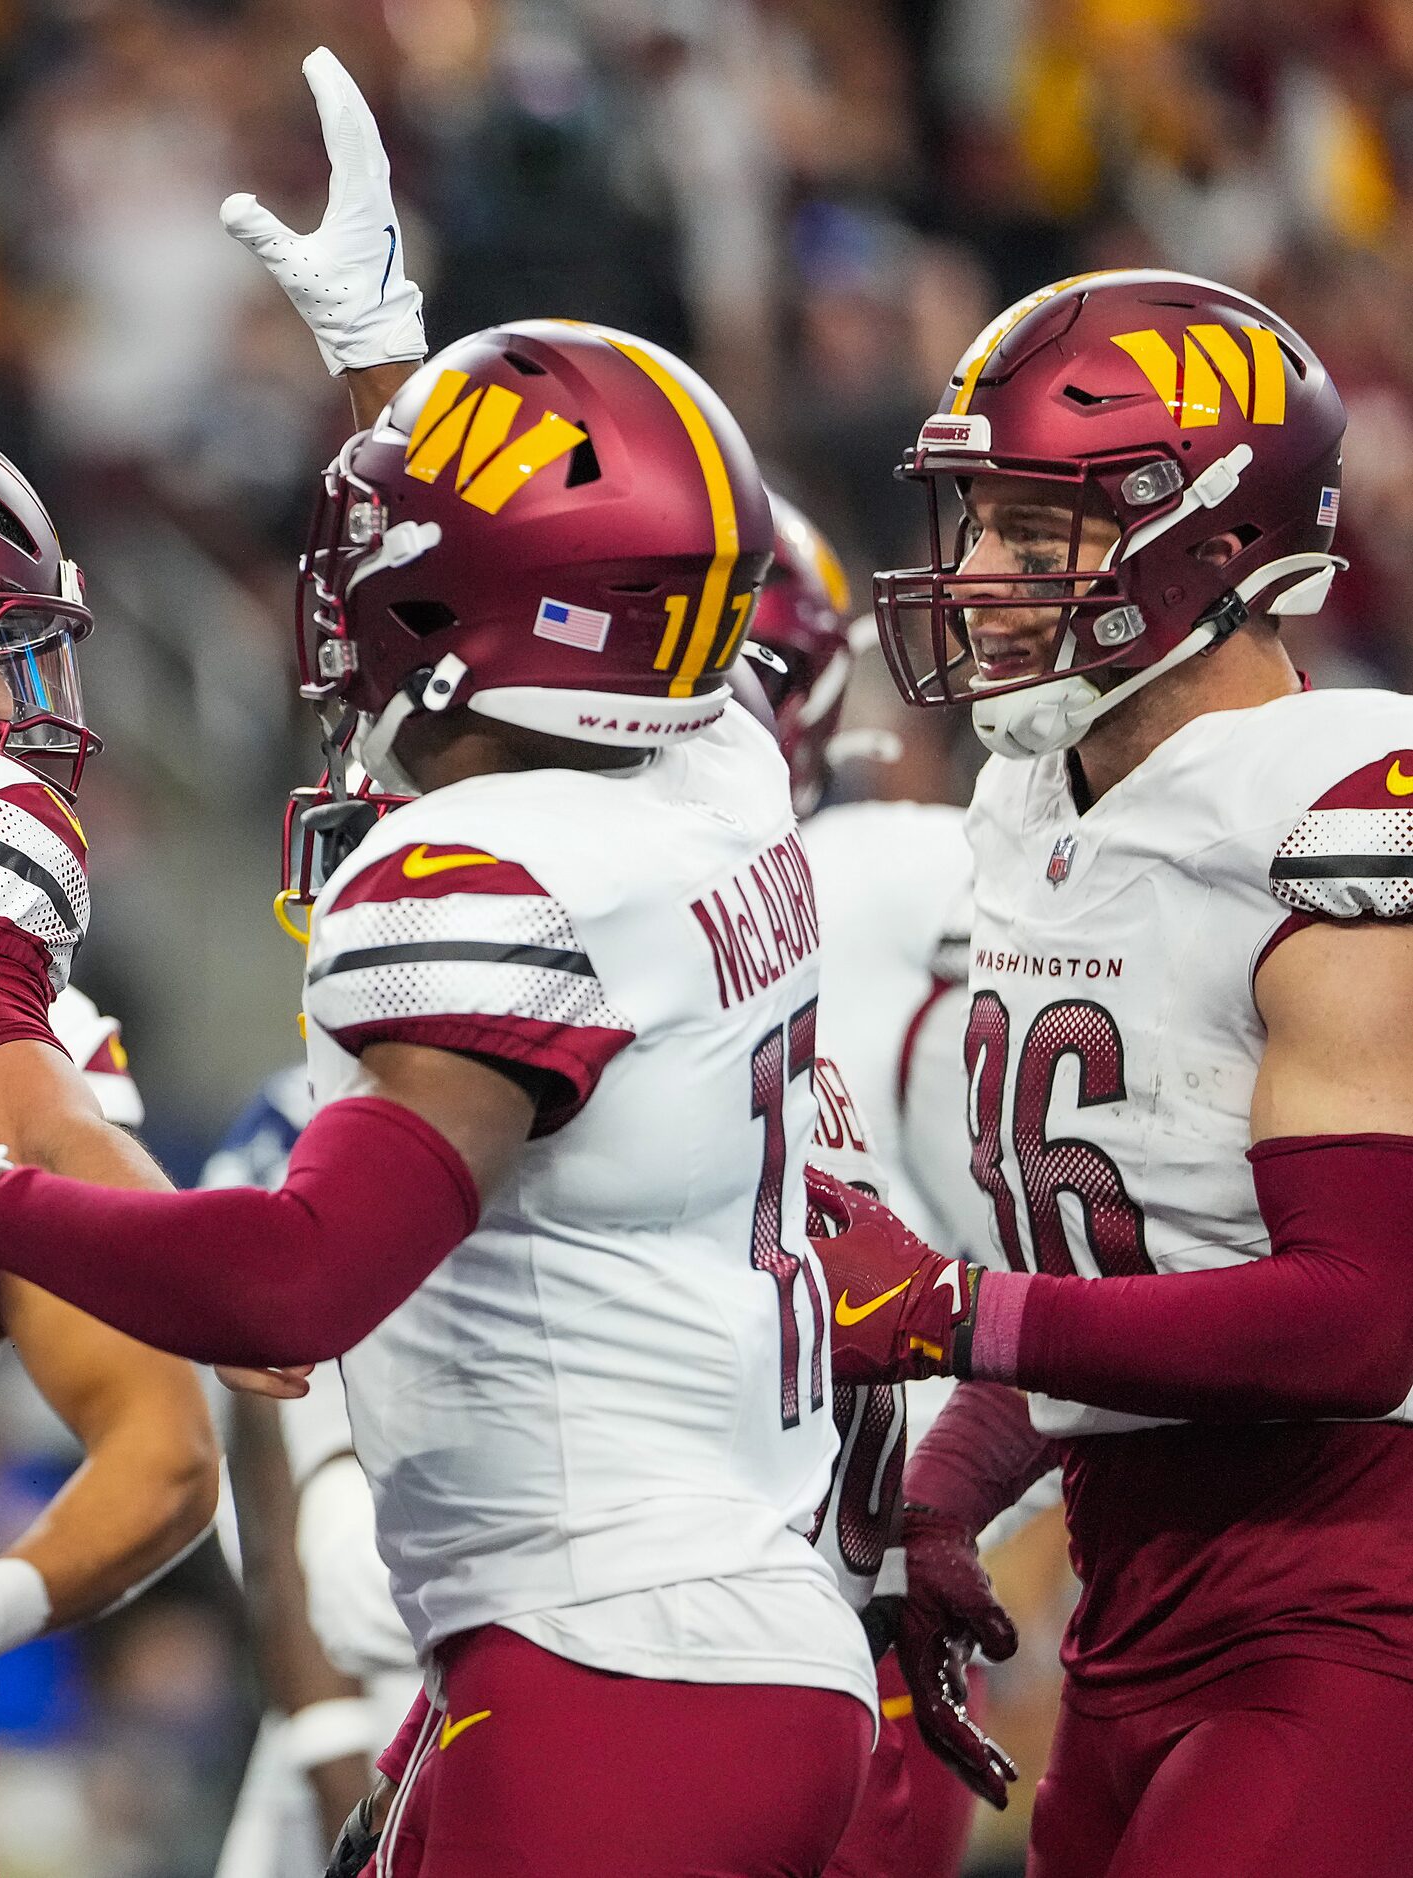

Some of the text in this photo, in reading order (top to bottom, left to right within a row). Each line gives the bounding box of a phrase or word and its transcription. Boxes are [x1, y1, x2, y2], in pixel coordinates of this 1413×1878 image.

[1109, 324, 1285, 429] W
[405, 369, 589, 515] W
[975, 950, 1124, 979] WASHINGTON
